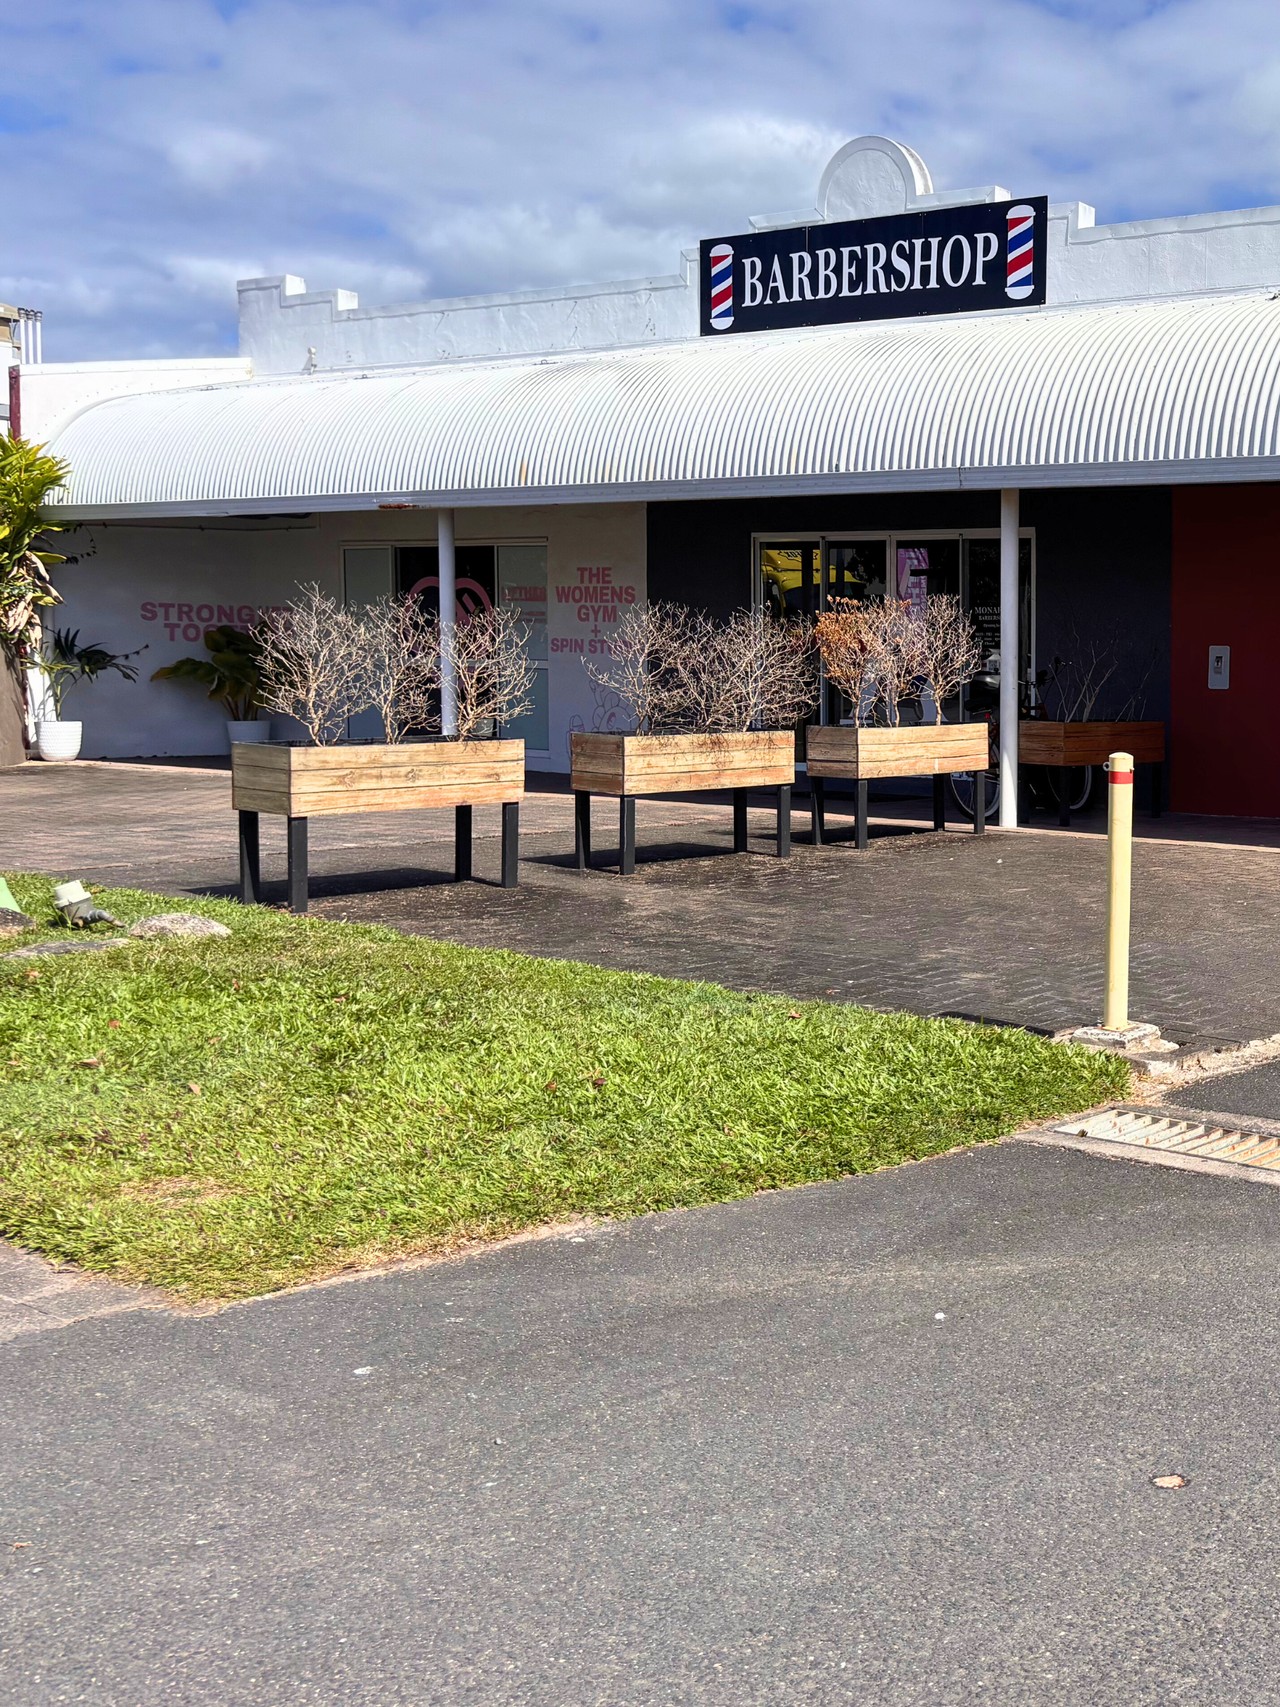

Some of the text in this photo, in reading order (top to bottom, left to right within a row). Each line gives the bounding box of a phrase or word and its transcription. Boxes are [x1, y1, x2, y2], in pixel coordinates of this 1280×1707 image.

[741, 232, 999, 308] BARBERSHOP
[577, 567, 612, 584] THE
[555, 585, 636, 604] WOMENS
[576, 604, 618, 622] GYM
[974, 606, 1001, 614] MONA
[550, 637, 584, 654] SPIN
